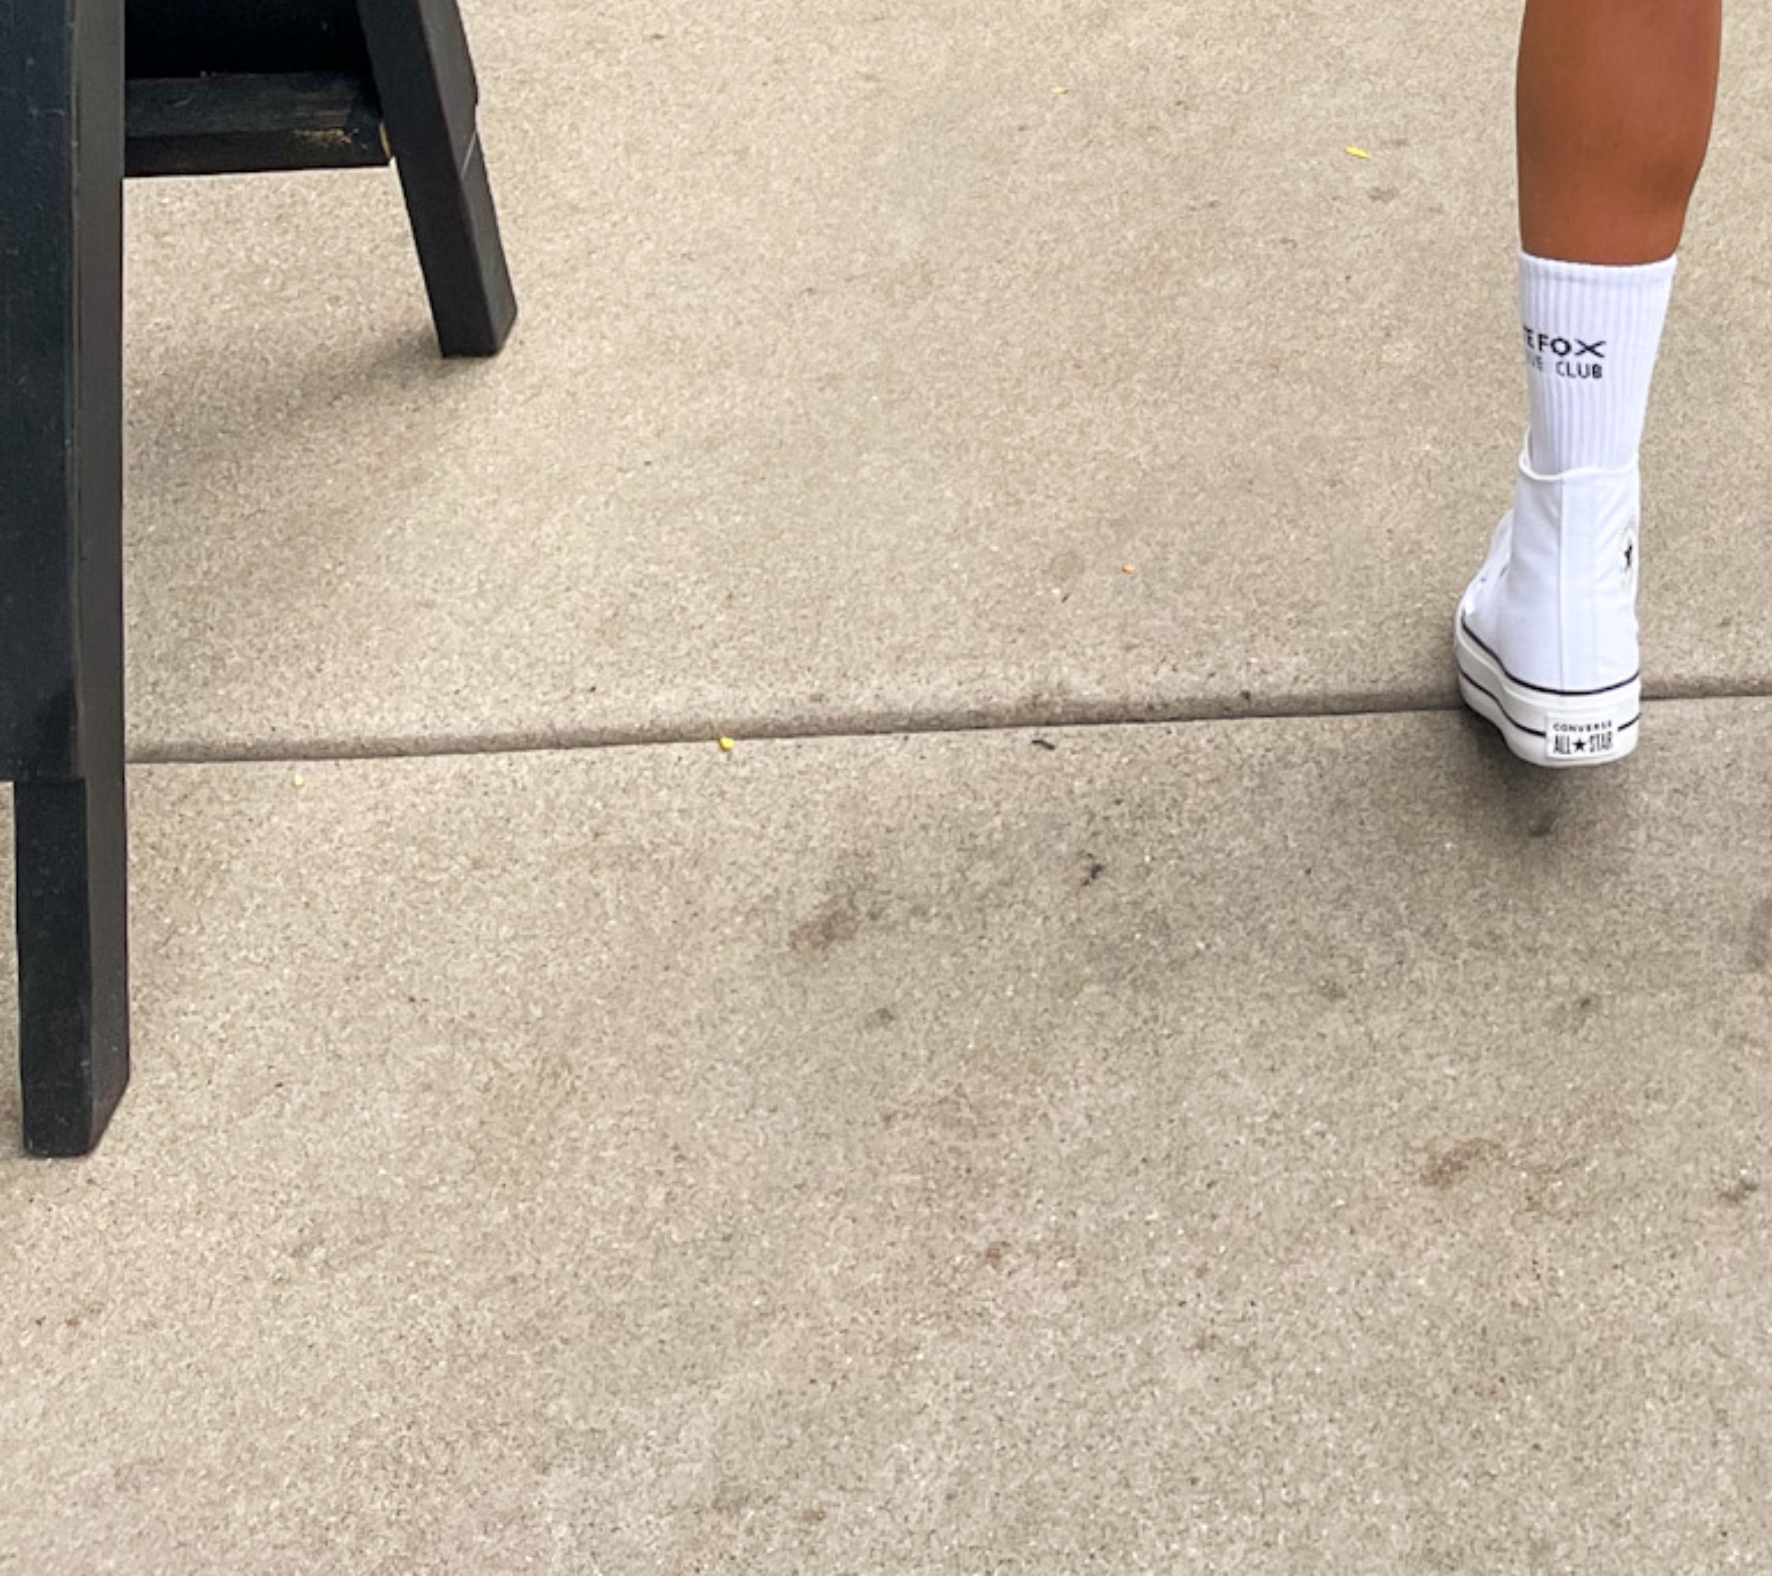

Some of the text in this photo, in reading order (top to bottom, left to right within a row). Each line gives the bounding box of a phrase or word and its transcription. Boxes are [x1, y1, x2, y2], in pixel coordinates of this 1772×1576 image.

[1555, 360, 1602, 379] CLUB
[1553, 731, 1613, 755] ALL STAR
